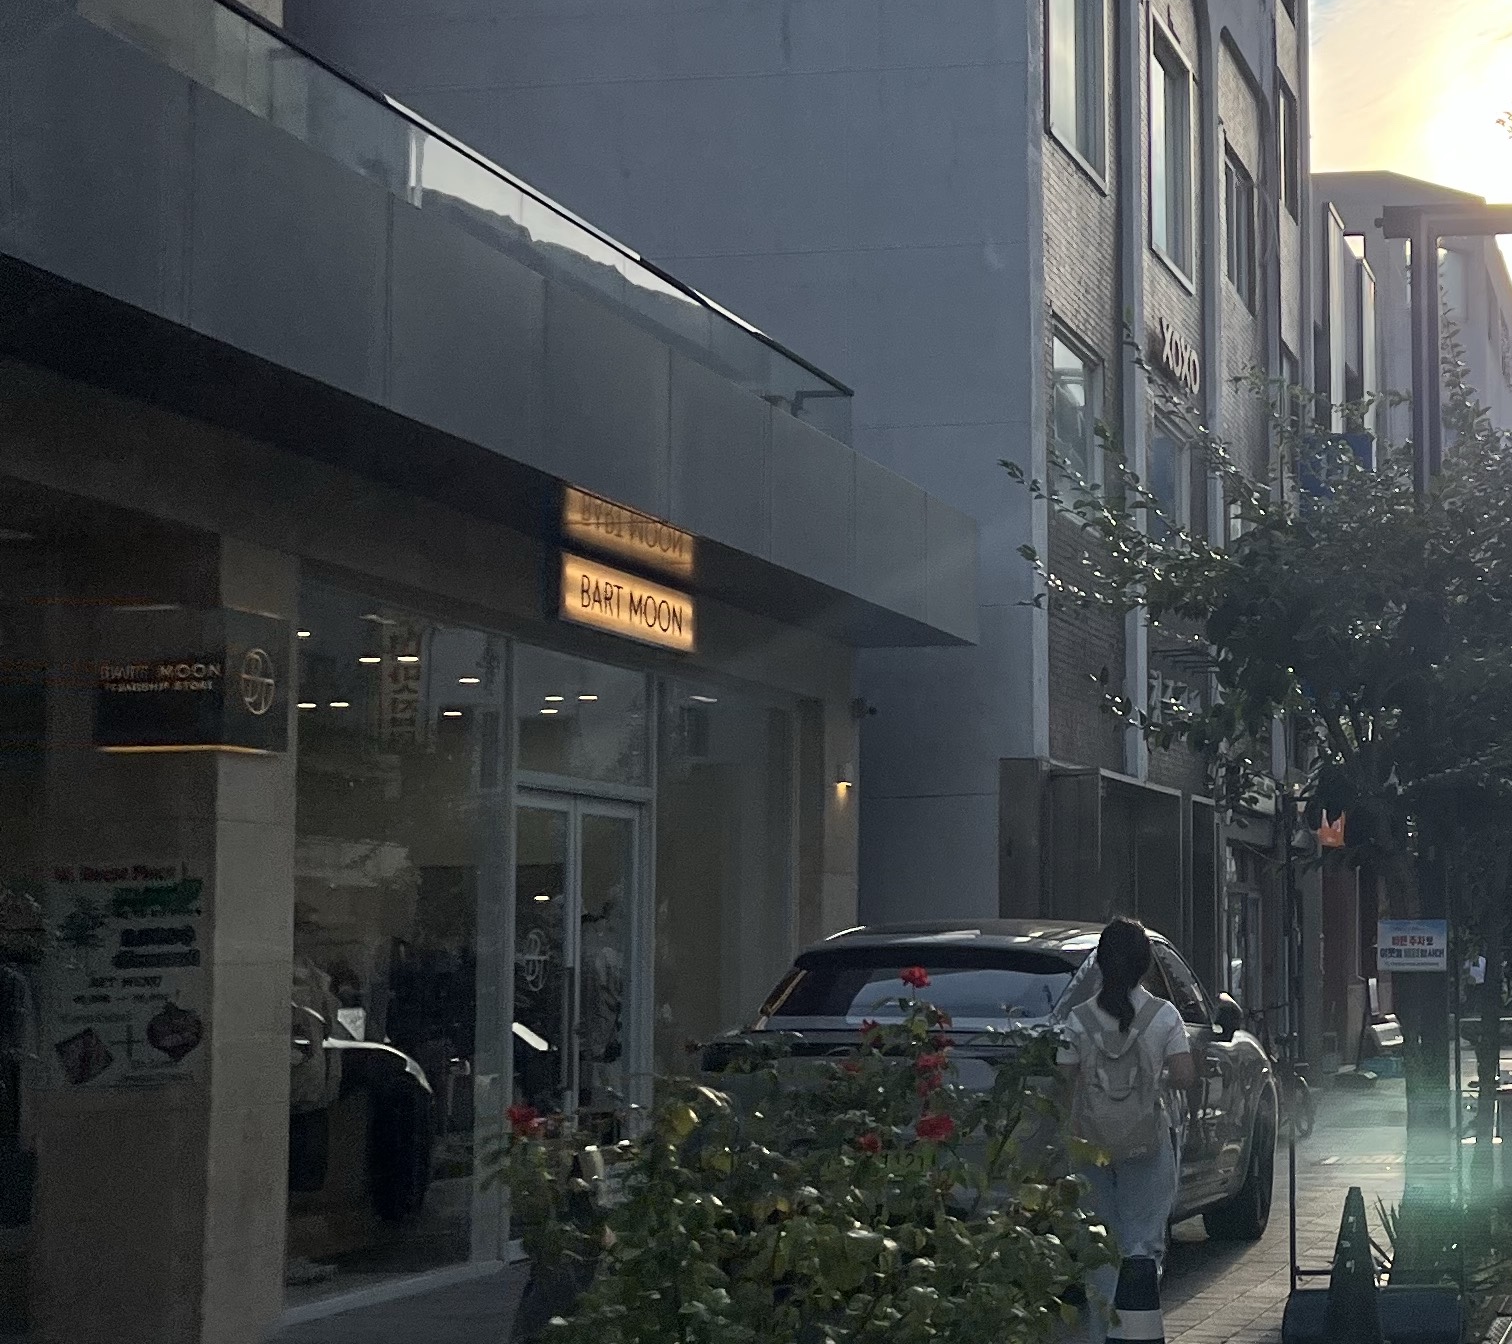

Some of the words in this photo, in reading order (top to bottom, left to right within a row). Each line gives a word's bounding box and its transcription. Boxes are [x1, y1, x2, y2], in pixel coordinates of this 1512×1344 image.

[1159, 316, 1200, 395] XOXO
[580, 574, 624, 619] BART
[628, 590, 683, 637] MOON
